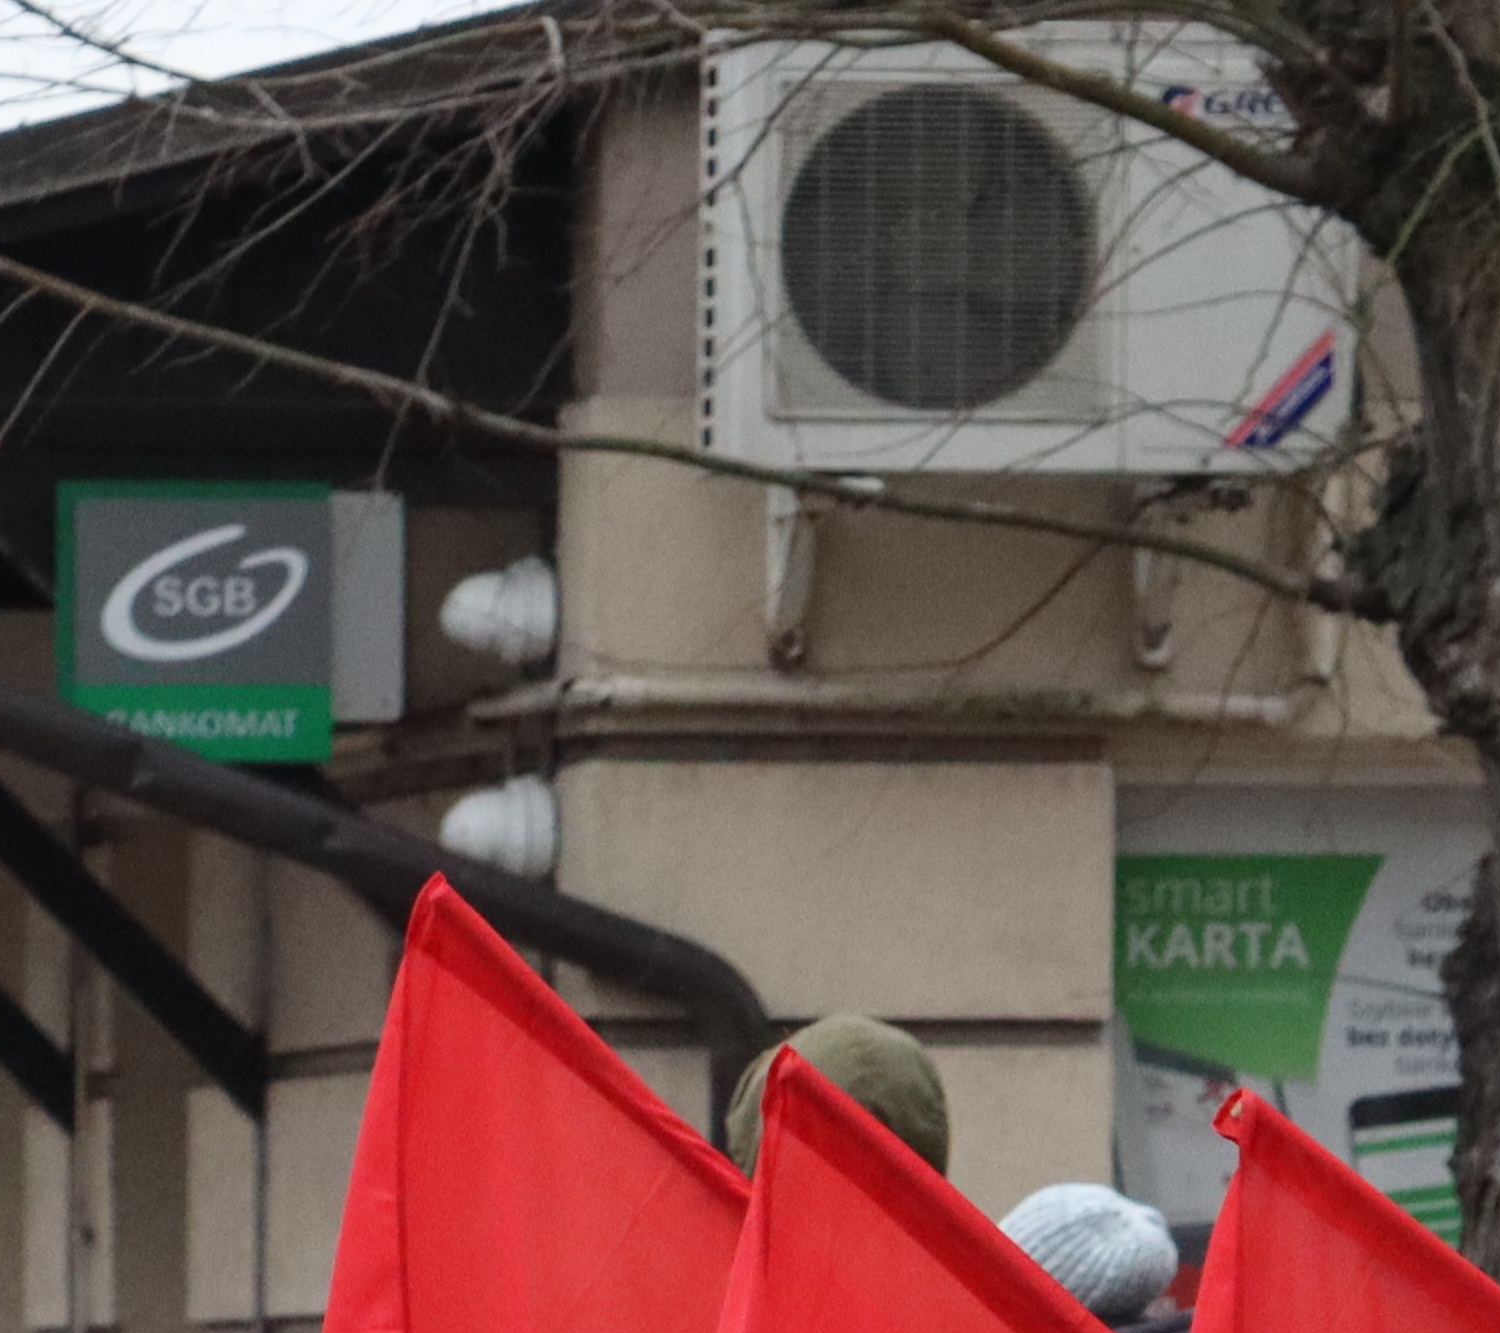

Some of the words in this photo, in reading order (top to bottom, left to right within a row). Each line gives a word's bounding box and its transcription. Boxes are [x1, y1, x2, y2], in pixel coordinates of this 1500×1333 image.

[152, 575, 258, 618] SGB
[1125, 872, 1277, 916] smart
[1126, 921, 1311, 969] KARTA
